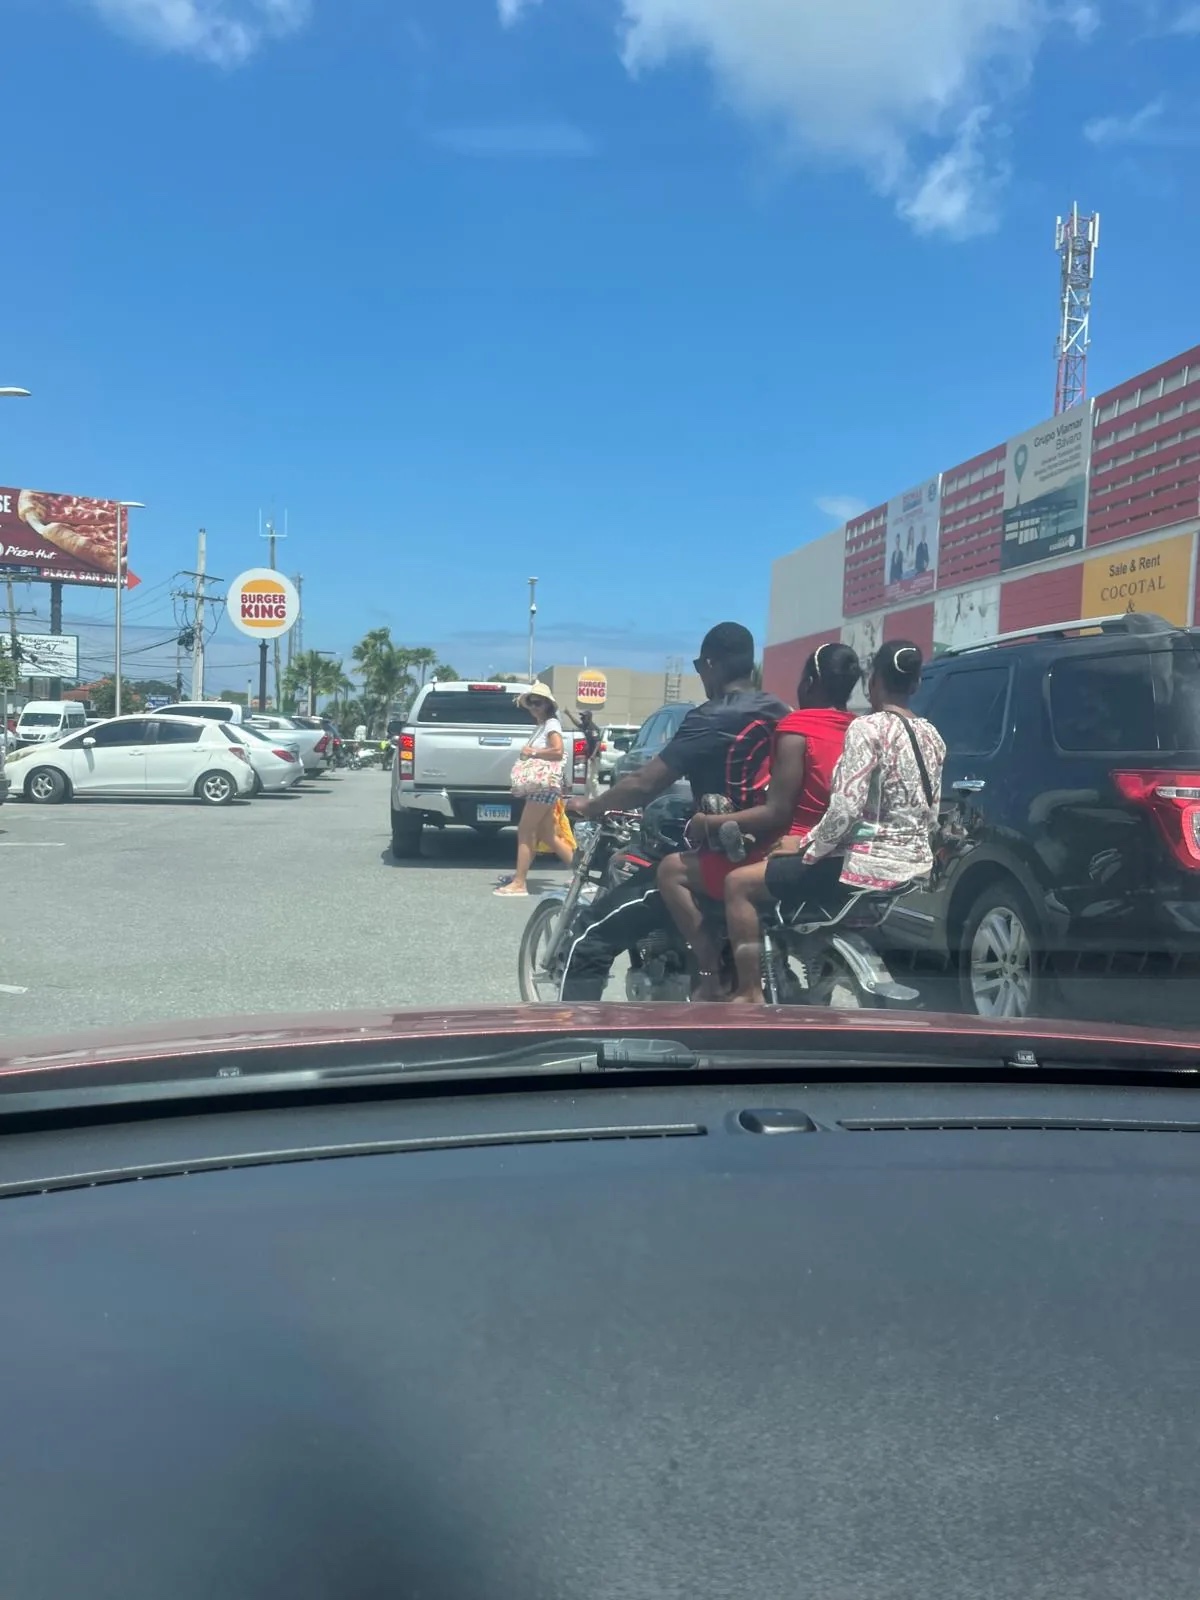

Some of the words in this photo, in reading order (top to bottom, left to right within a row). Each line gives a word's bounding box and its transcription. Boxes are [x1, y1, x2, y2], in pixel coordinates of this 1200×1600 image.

[5, 546, 34, 557] Pizza
[1109, 563, 1127, 577] Sale
[1129, 560, 1136, 572] &
[1139, 554, 1160, 570] Rent
[1101, 576, 1166, 601] COCOTAL
[241, 594, 286, 604] BURGER
[241, 604, 287, 618] KING
[578, 688, 606, 697] KING
